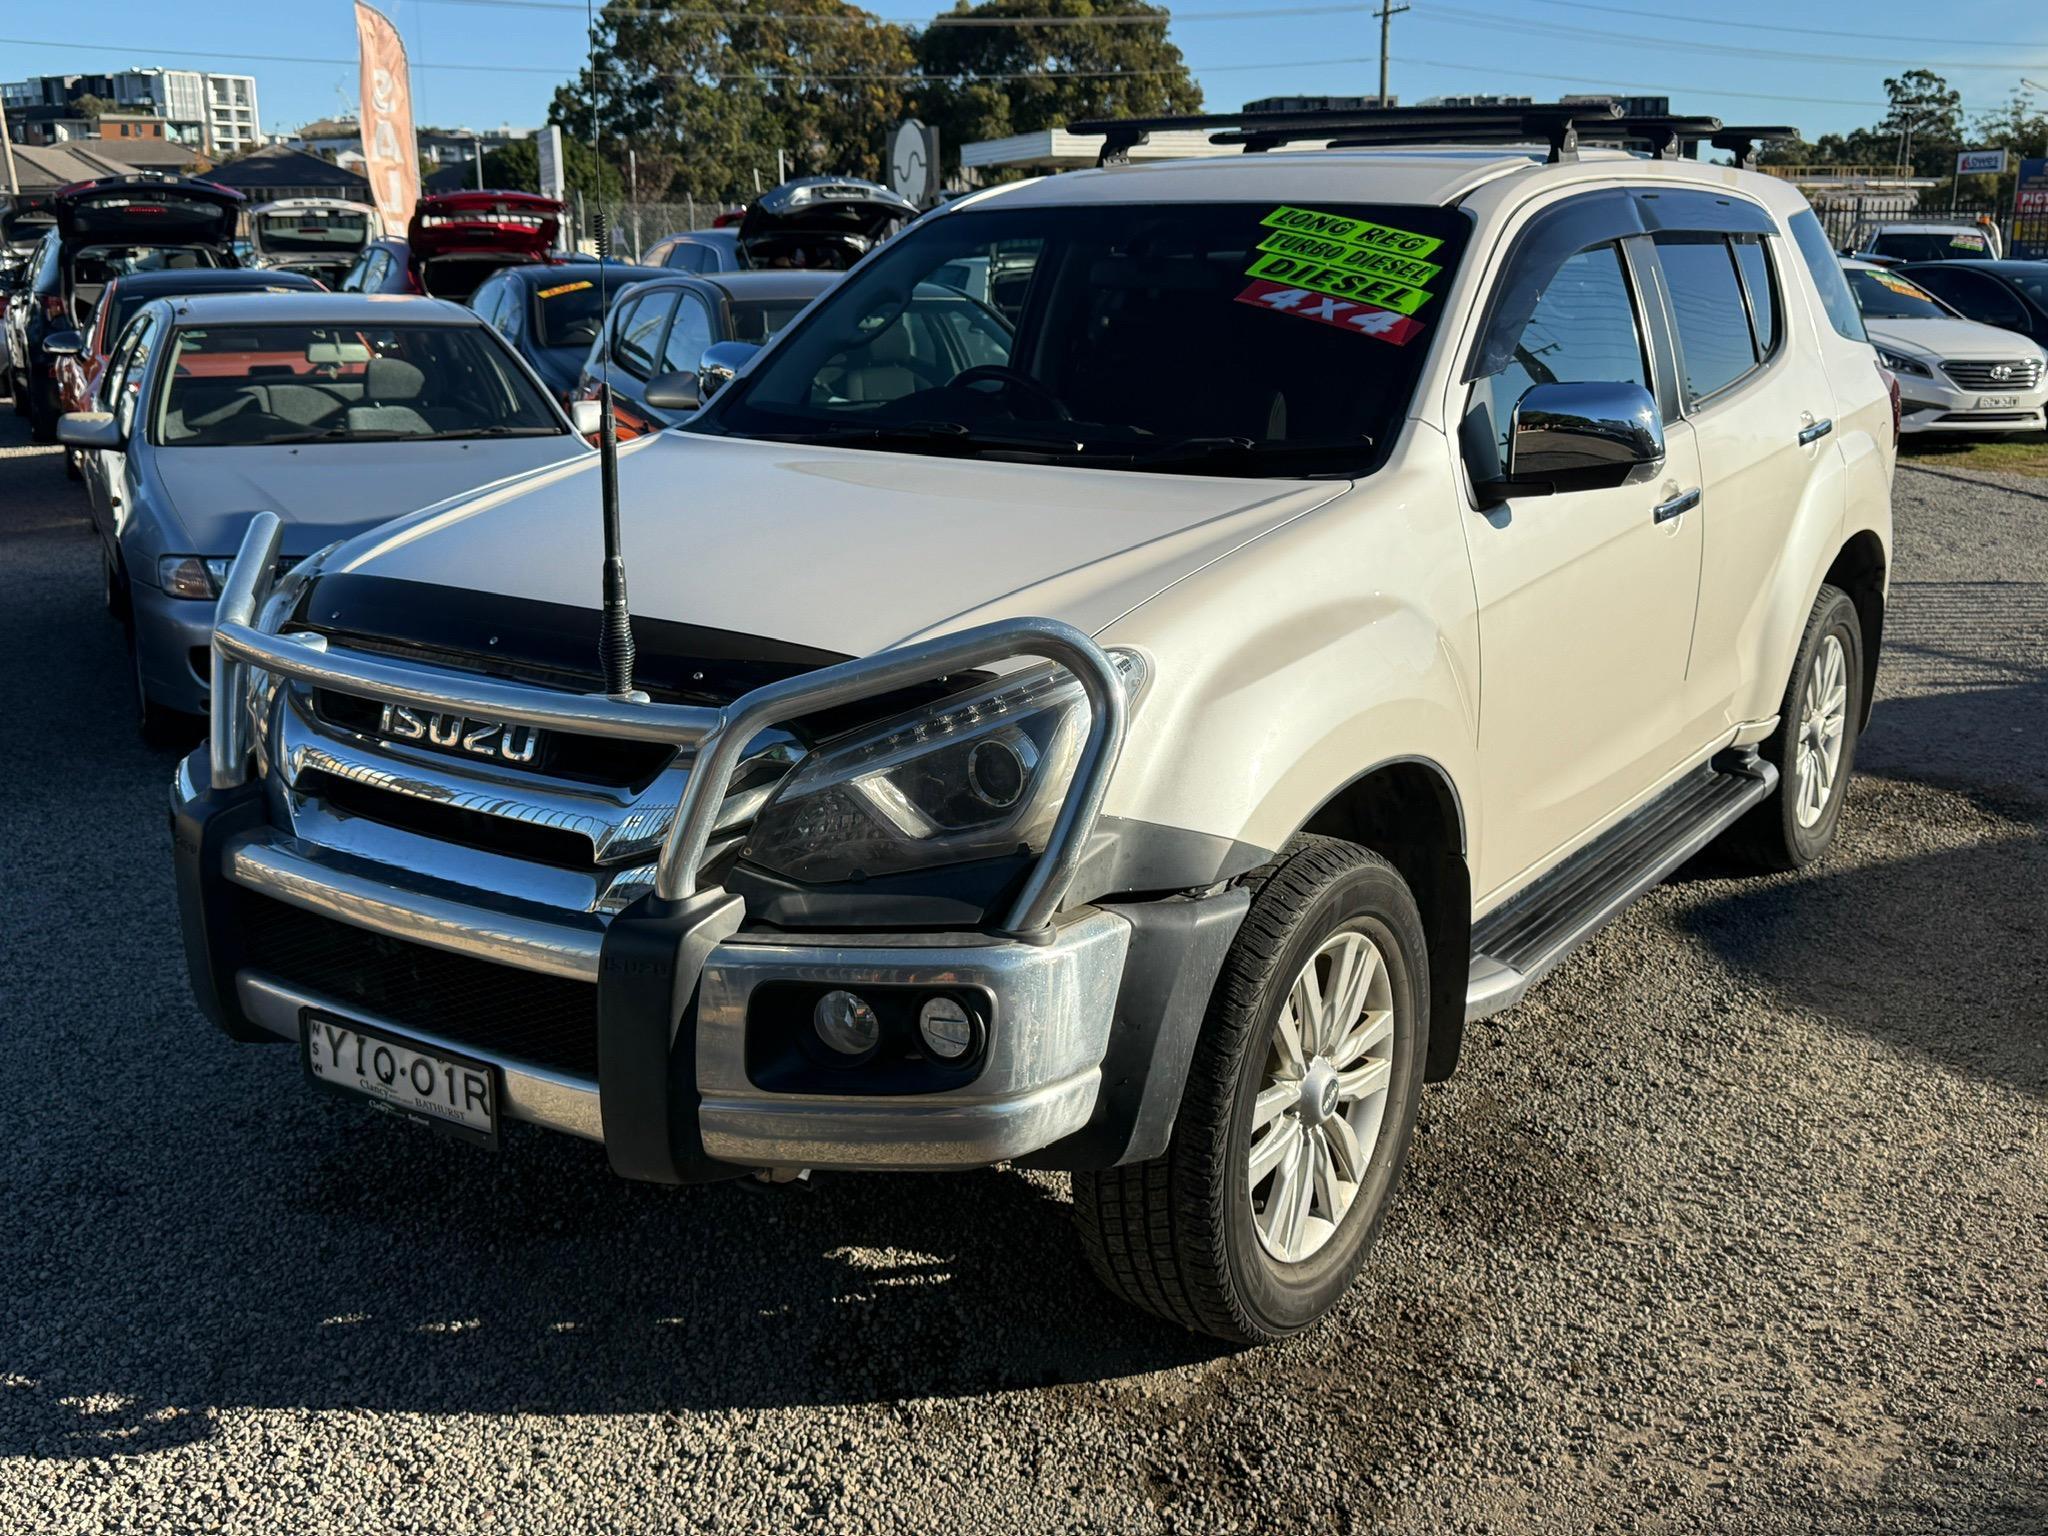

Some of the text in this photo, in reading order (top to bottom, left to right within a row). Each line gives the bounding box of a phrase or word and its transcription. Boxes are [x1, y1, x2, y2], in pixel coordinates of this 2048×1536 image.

[1273, 210, 1429, 251] LONG REG
[1265, 233, 1433, 282] TURBO DIESEL
[1260, 258, 1413, 307] DIESEL
[1258, 288, 1405, 335] 4X4
[380, 703, 538, 762] ISUZU
